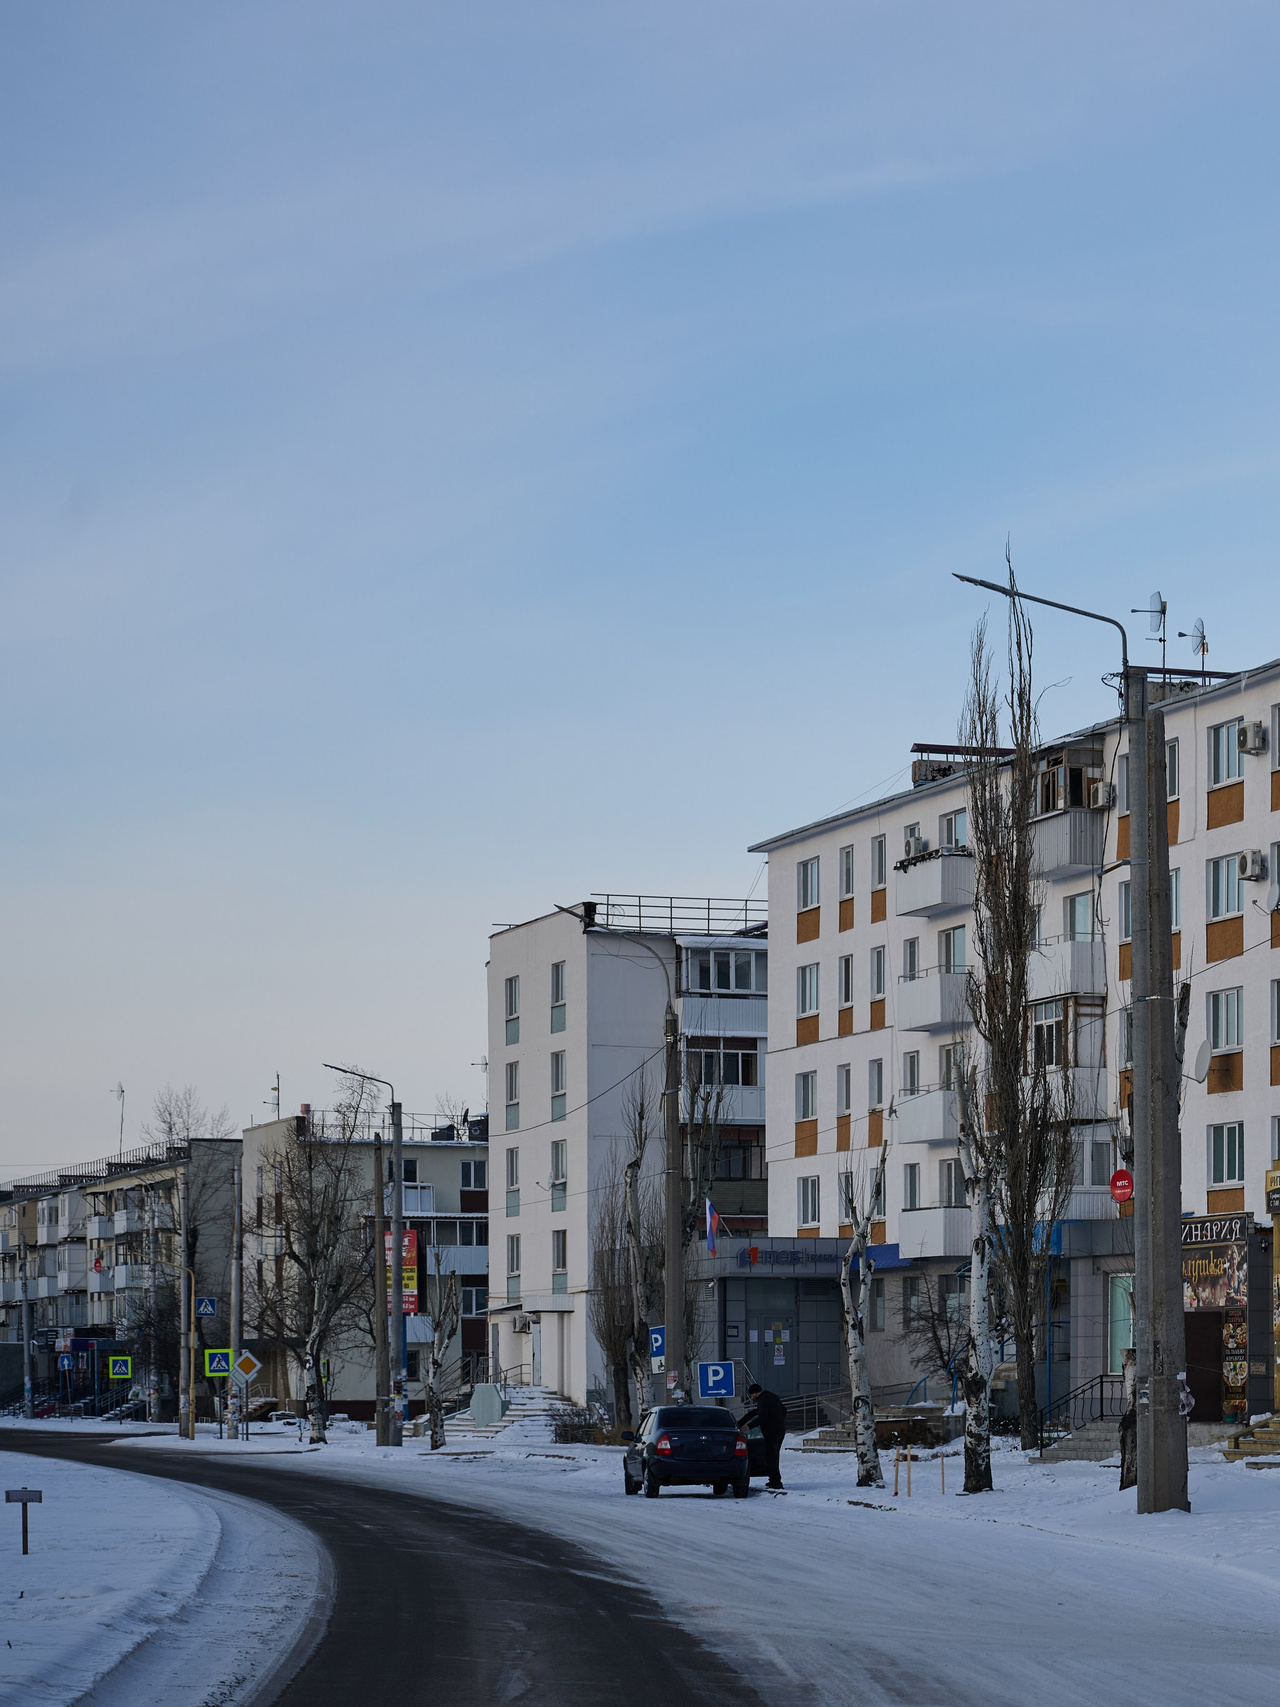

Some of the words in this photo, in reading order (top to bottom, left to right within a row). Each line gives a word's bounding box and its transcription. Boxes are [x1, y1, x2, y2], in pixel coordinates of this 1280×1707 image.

[1181, 1219, 1241, 1243] ИНАРИЯ
[763, 1249, 801, 1265] ПСБ
[707, 1365, 725, 1387] P
